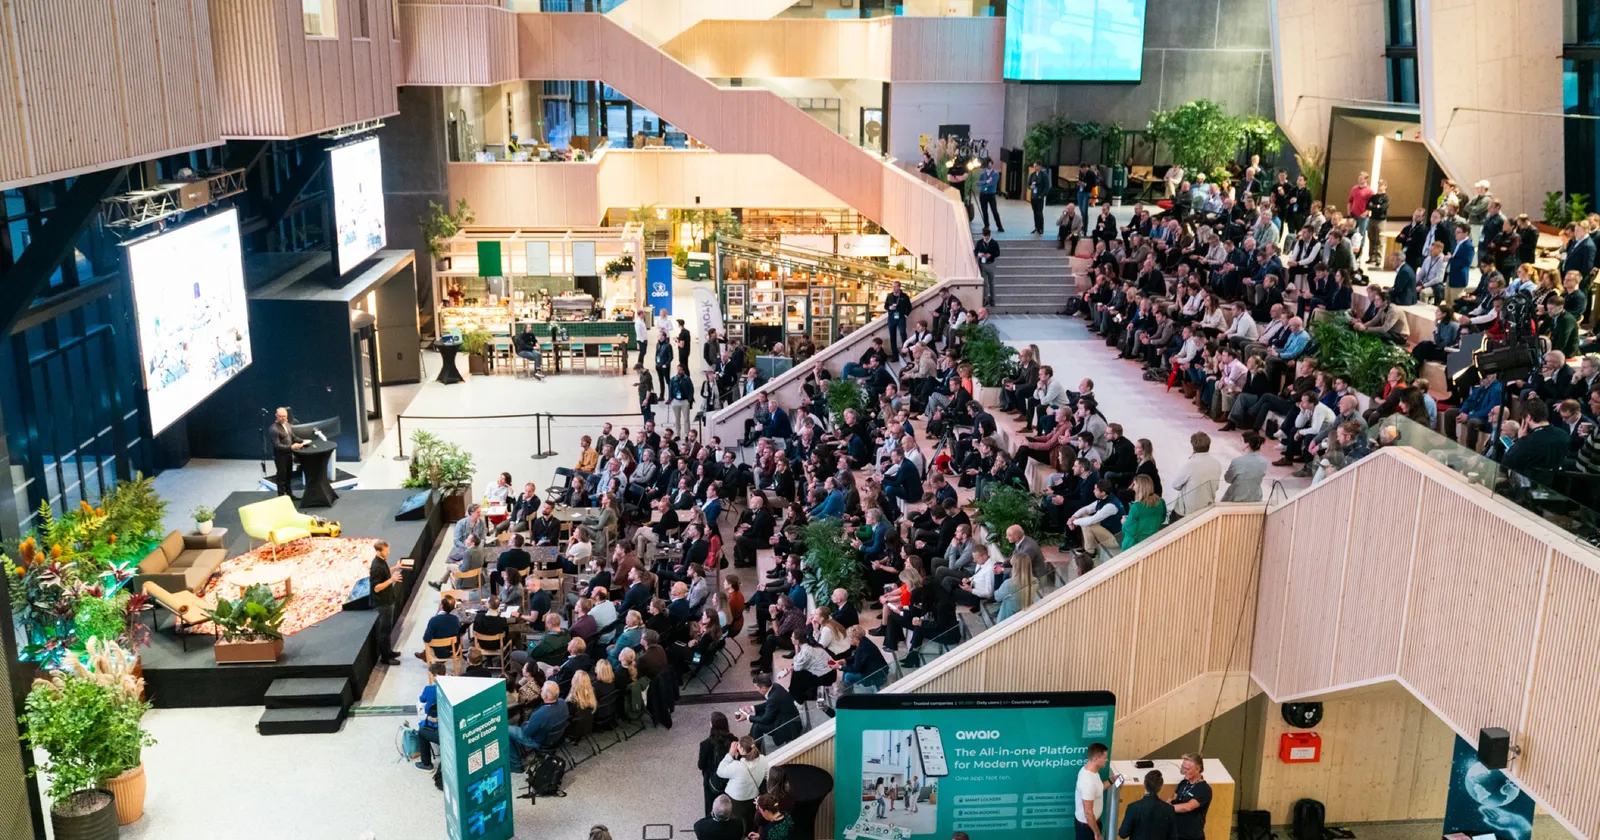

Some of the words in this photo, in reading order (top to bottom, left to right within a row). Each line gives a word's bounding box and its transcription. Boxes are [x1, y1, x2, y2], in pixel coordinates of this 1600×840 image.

[462, 715, 501, 740] Futureproofing
[467, 733, 480, 745] Real
[480, 725, 497, 738] Estate
[955, 730, 1000, 740] awaio
[954, 748, 976, 757] The
[978, 747, 1036, 757] All-in-one
[1039, 745, 1089, 756] Platform
[954, 761, 970, 770] for
[973, 760, 1019, 769] Modern
[1021, 758, 1089, 769] Workplaces
